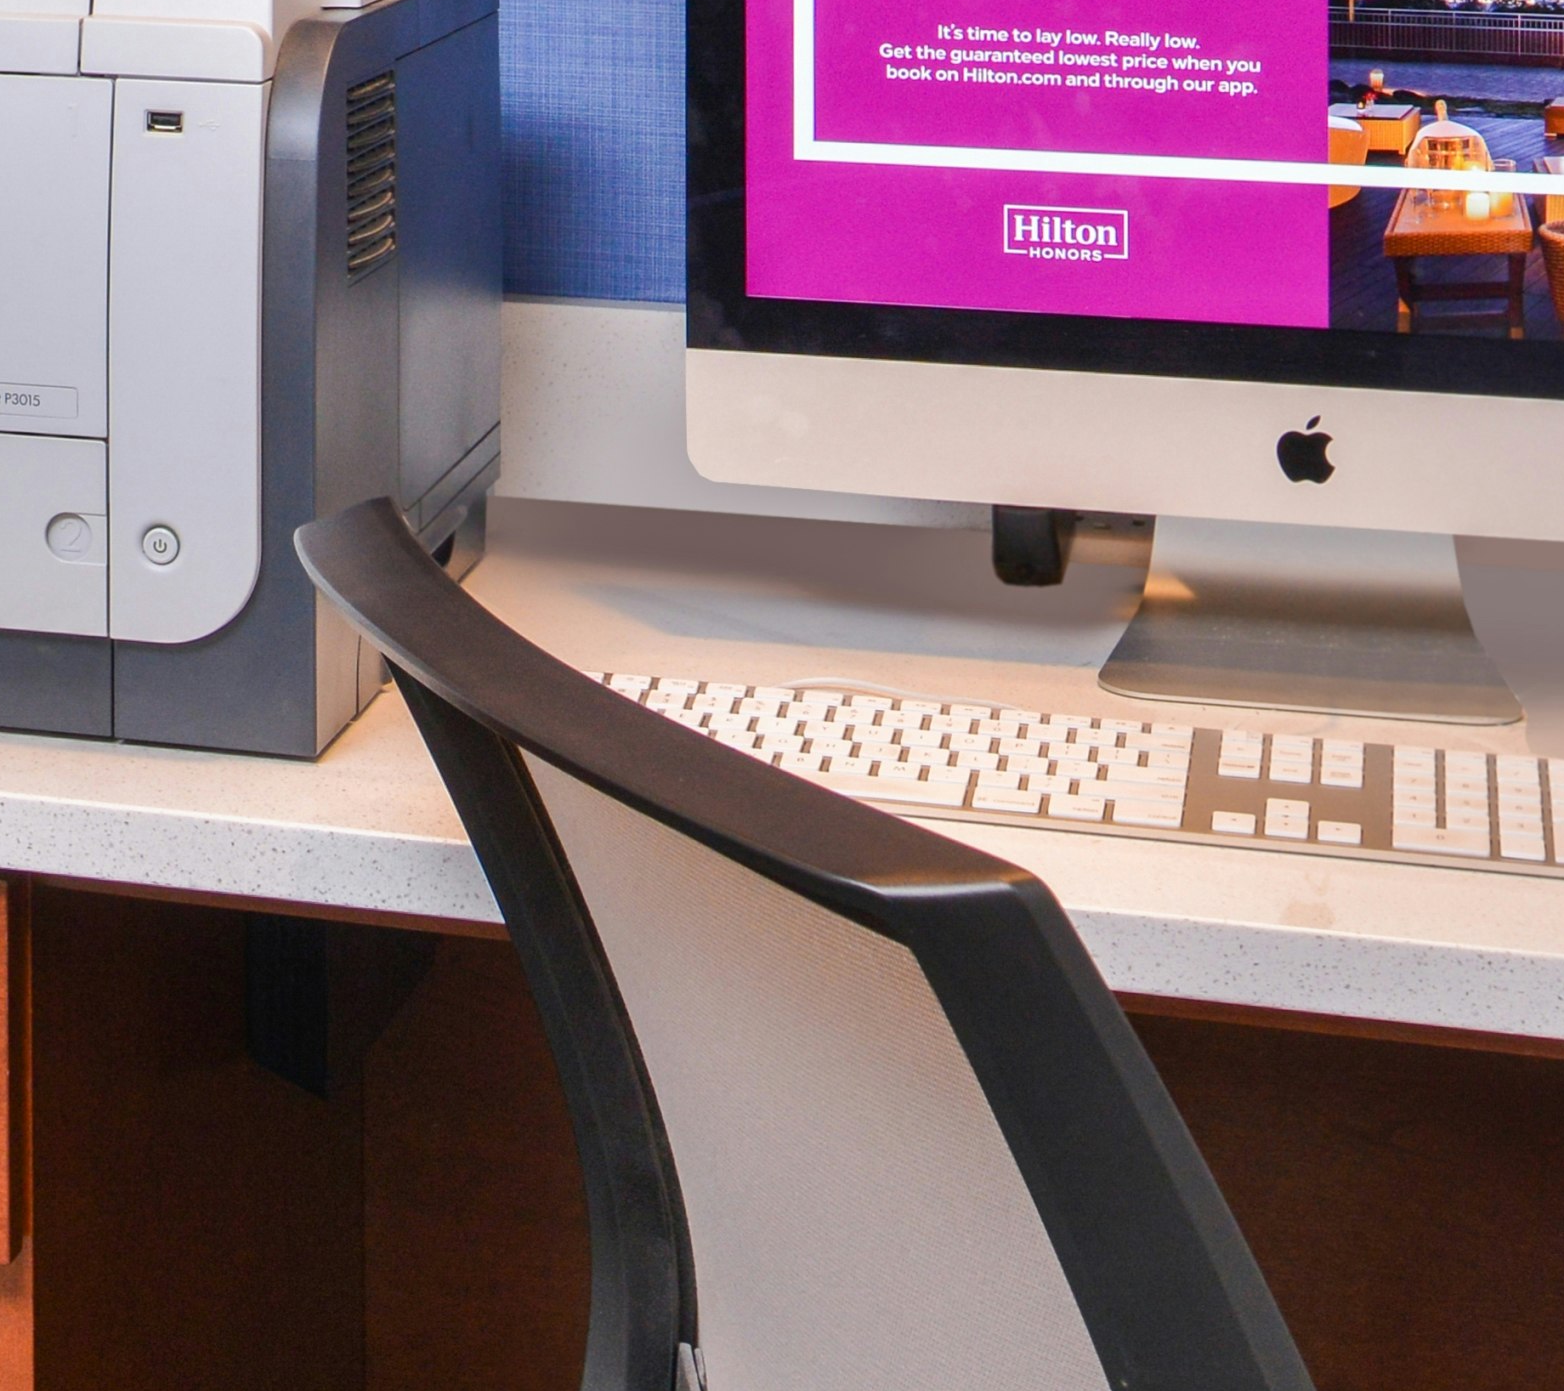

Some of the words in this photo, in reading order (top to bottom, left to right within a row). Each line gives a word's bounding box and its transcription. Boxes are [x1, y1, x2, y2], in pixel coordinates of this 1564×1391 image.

[966, 25, 1009, 42] time
[1011, 27, 1033, 43] to
[1035, 28, 1063, 48] lay
[1065, 28, 1102, 46] low.
[1104, 30, 1161, 51] Really
[1164, 31, 1201, 49] low.
[878, 42, 913, 59] Get
[915, 44, 947, 61] the
[949, 47, 1055, 66] guaranteed
[1058, 50, 1118, 67] lowest
[1121, 52, 1169, 72] price
[1171, 54, 1223, 72] when
[1225, 59, 1262, 76] you
[885, 63, 932, 81] book
[935, 68, 960, 83] on
[962, 66, 1062, 87] Hilton.com
[1065, 71, 1101, 89] and
[1103, 72, 1179, 95] through
[1182, 78, 1215, 93] our
[1218, 79, 1259, 97] app.
[1012, 213, 1119, 247] Hilton
[1028, 245, 1103, 262] HONORS
[4, 393, 41, 408] P3015
